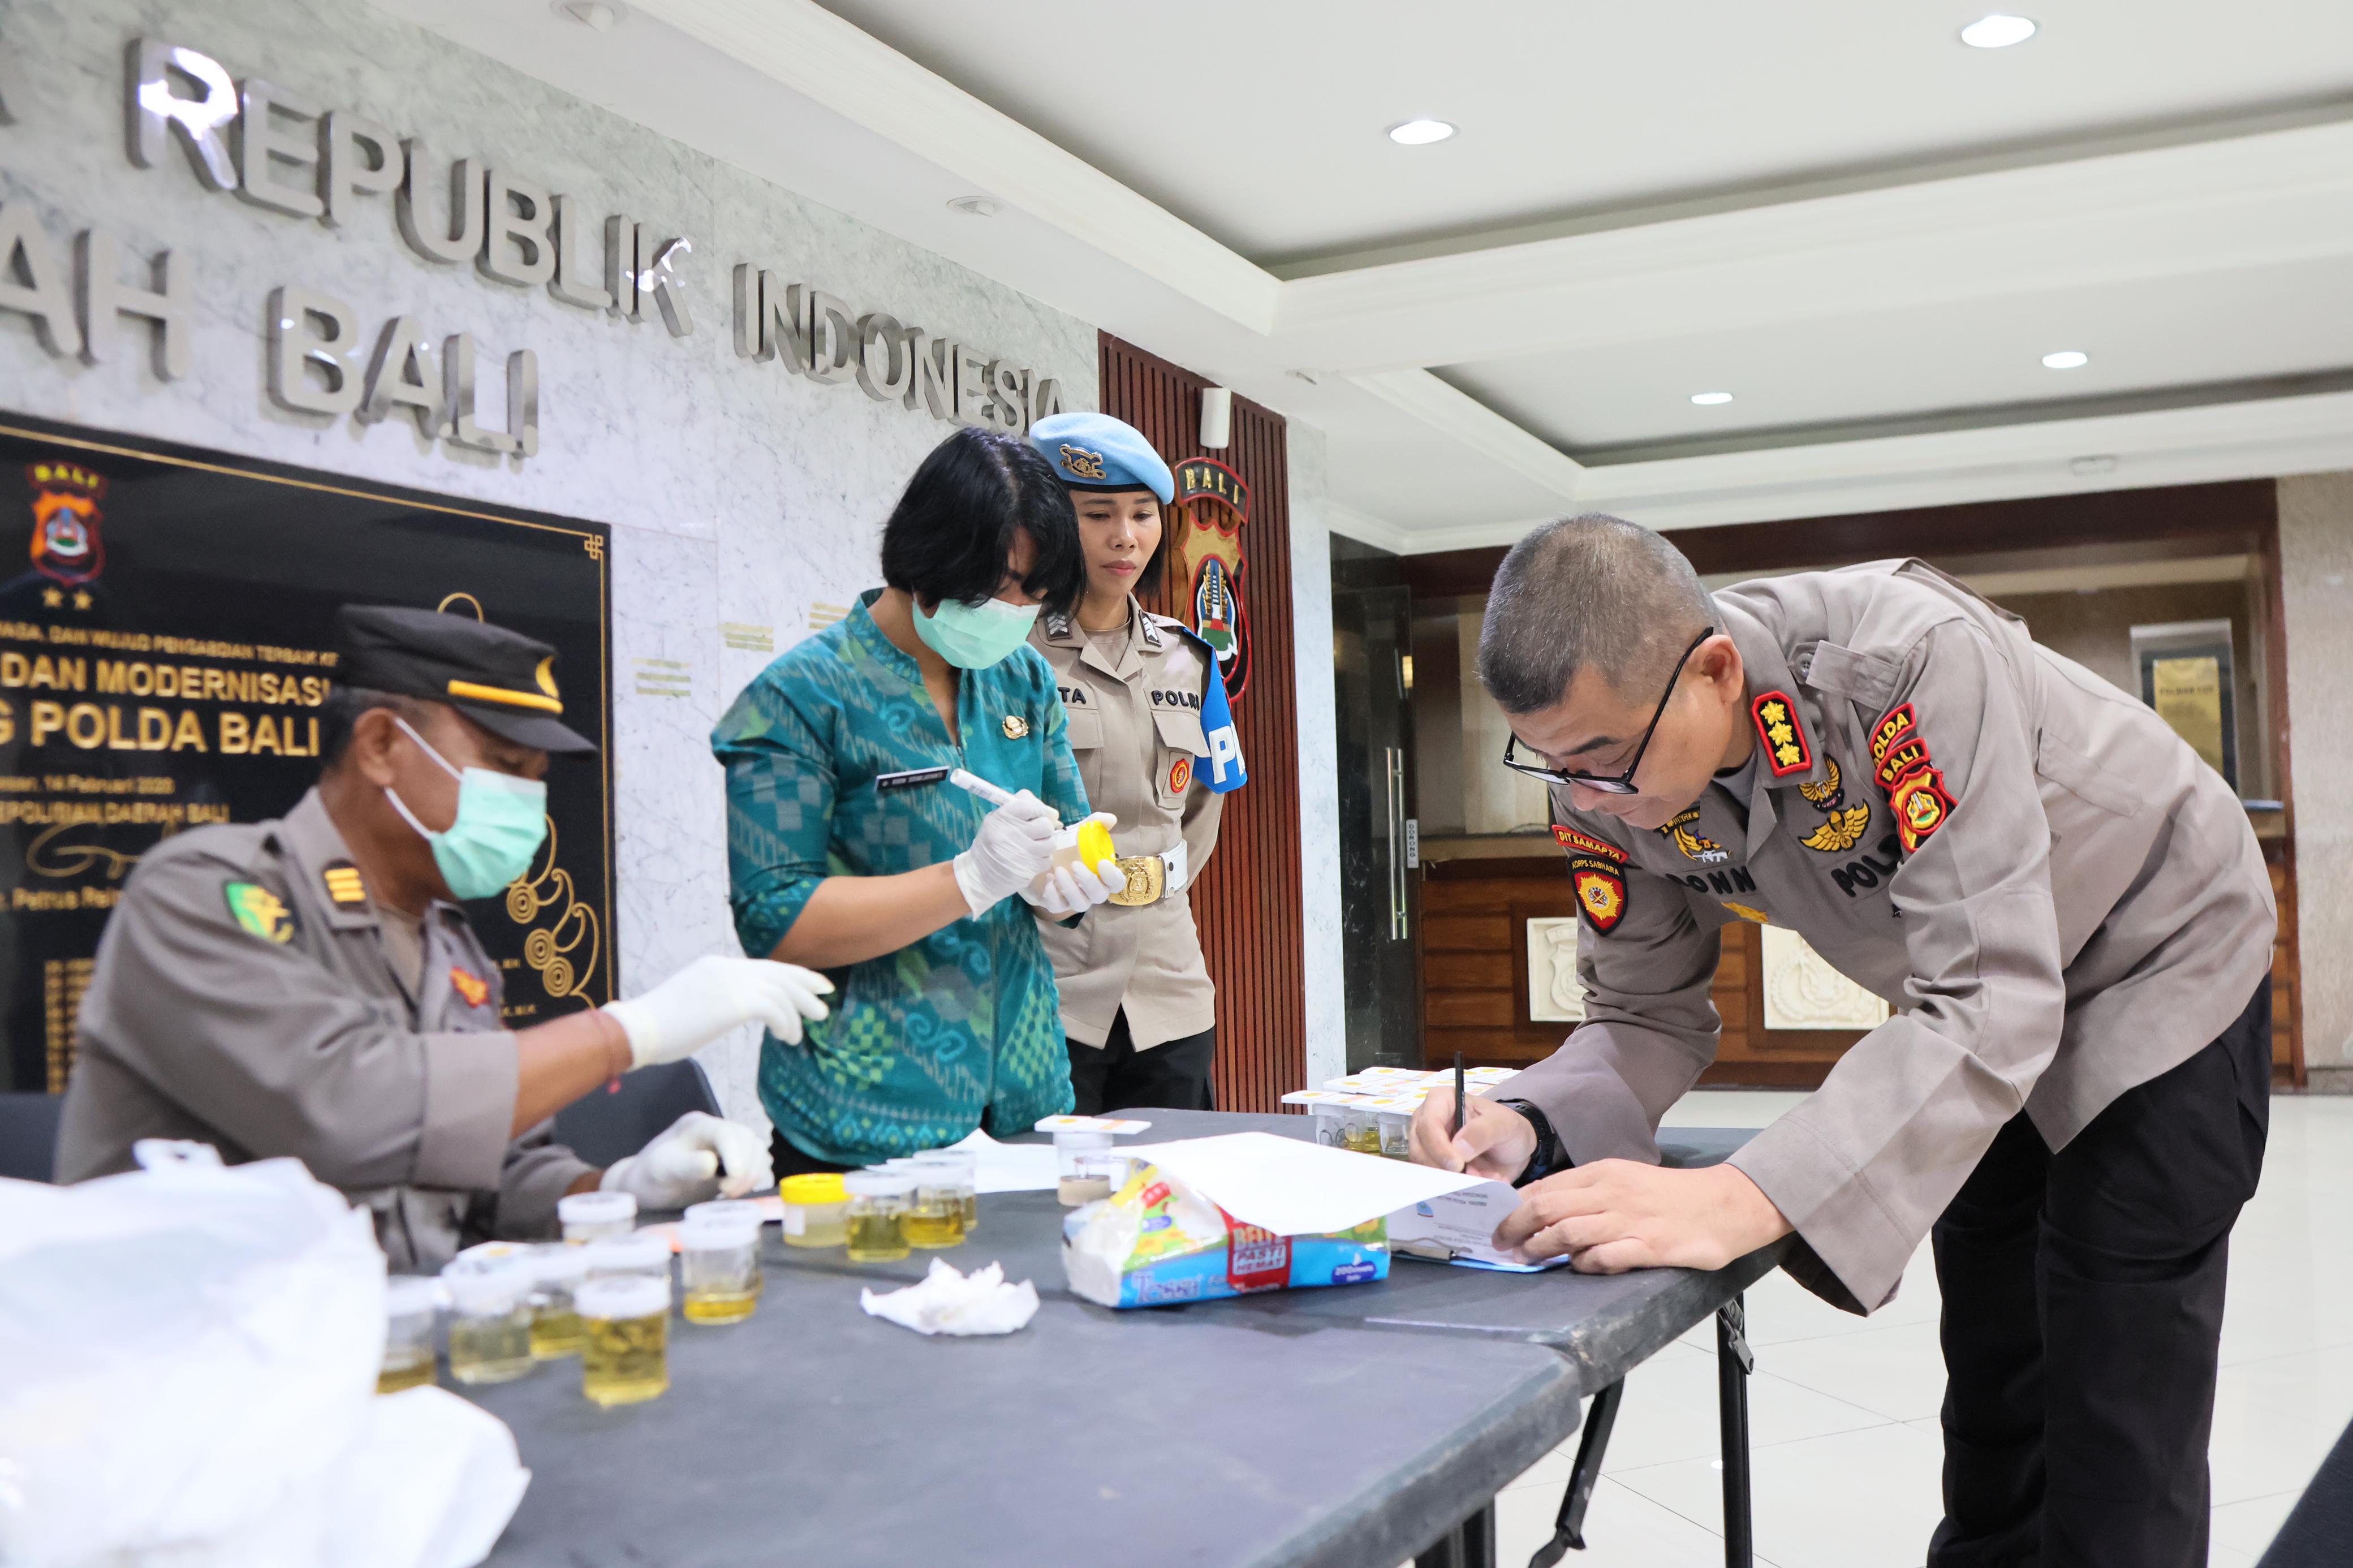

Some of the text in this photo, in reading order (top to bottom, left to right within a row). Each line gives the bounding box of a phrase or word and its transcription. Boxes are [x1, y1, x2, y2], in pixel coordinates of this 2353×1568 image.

[124, 37, 693, 337] REPUBLIK
[267, 286, 539, 456] BALI
[1185, 467, 1239, 505] BALI
[1, 652, 87, 692] DAN
[1057, 687, 1086, 704] TA
[1151, 690, 1200, 711] POLRI
[31, 701, 208, 753] POLDA
[220, 712, 320, 756] BALI
[1882, 745, 1919, 782] BALI
[187, 803, 230, 824] BALI
[1558, 830, 1620, 860] DIT SAMAPTA
[1571, 859, 1620, 877] KORPS SABHARA
